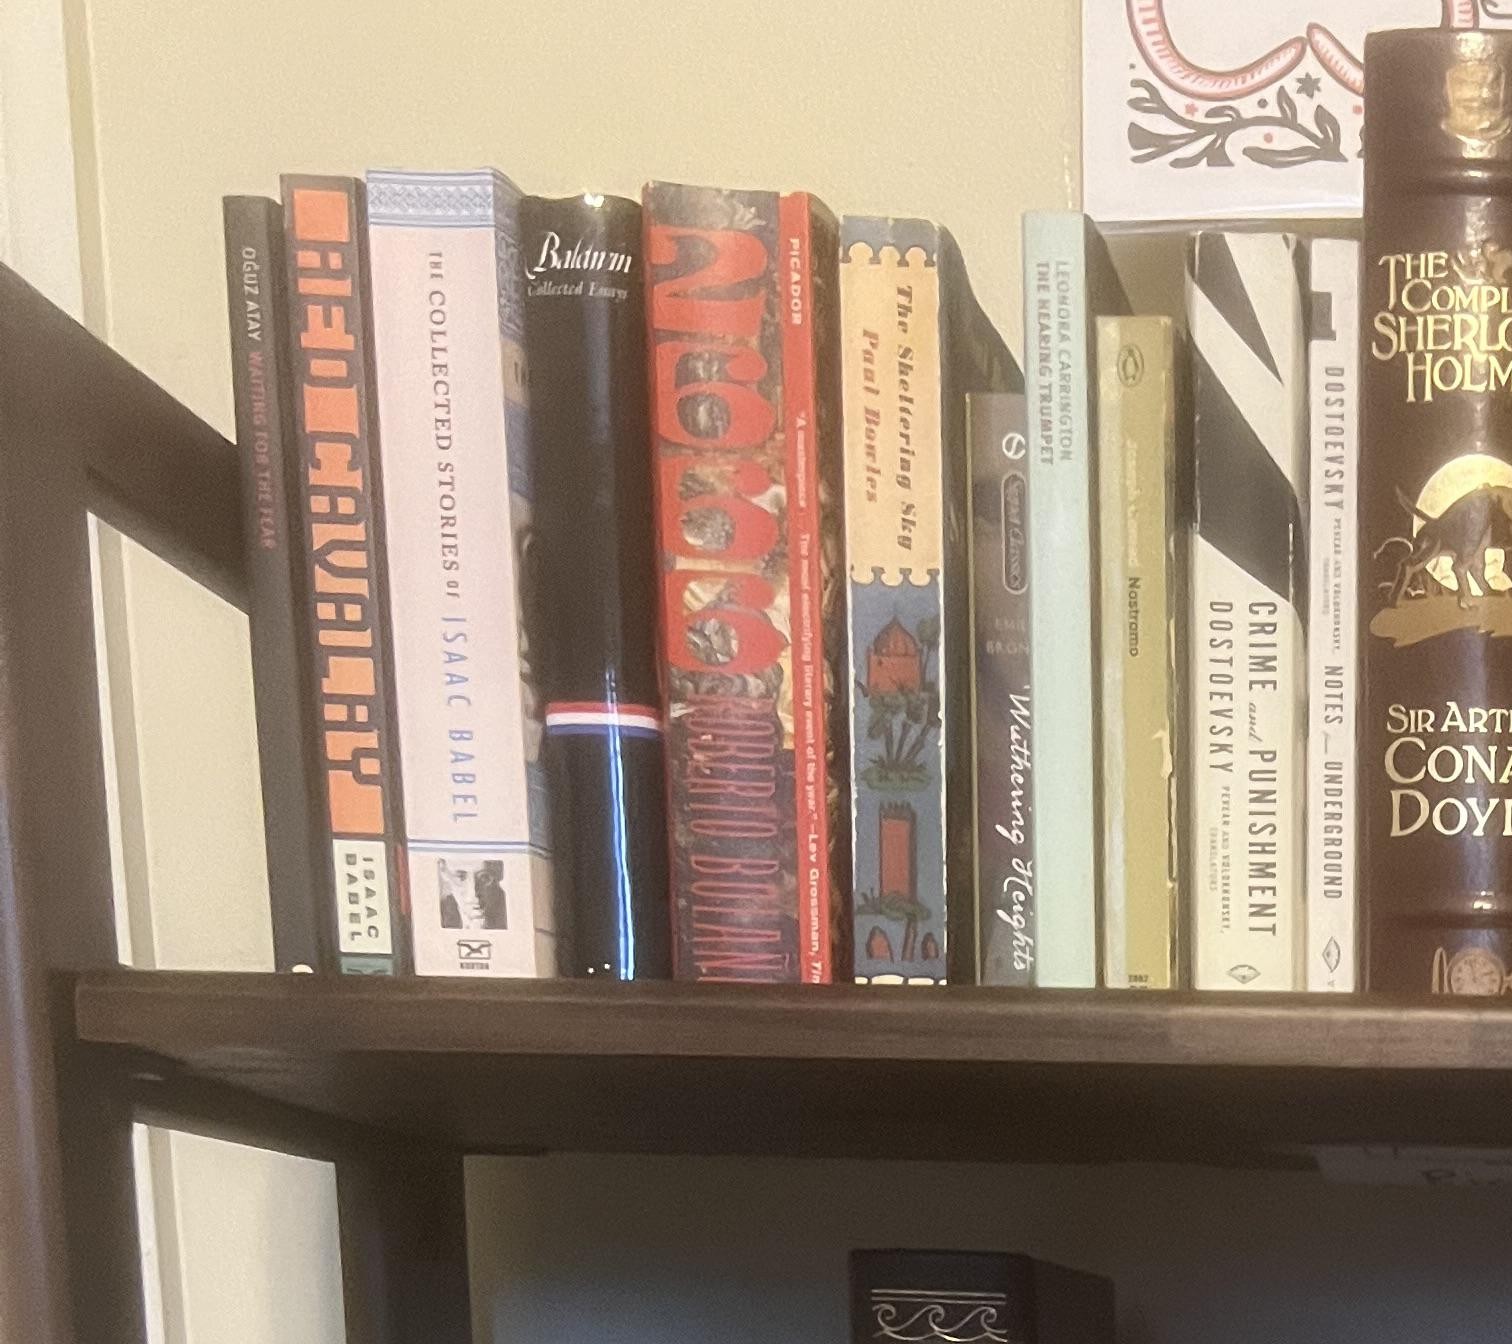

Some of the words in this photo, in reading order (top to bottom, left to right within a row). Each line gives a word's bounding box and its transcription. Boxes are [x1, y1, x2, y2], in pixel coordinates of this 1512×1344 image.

[429, 252, 443, 280] THE
[789, 237, 802, 326] PICADOR
[897, 284, 914, 335] The
[1036, 261, 1050, 289] THE
[1055, 259, 1071, 343] LEONORA
[1378, 251, 1450, 312] THE
[244, 300, 262, 342] ATAY
[862, 329, 881, 396] Paul
[1037, 292, 1052, 379] HEARING
[428, 290, 454, 451] COLLECTED
[1058, 345, 1074, 463] CARRINGTON
[863, 406, 881, 504] Bowles
[896, 344, 915, 492] Sheltering
[1039, 383, 1054, 467] TRUMPET
[1324, 366, 1345, 512] DOSTOEVSKY
[437, 462, 459, 572] STORIES
[896, 501, 917, 552] Sky
[1126, 576, 1141, 658] Nostromo
[1248, 601, 1278, 692] CRIME
[441, 617, 472, 707] ISAAC
[1208, 601, 1234, 774] DOSTOEVSKY
[1323, 665, 1344, 726] NOTES
[1248, 703, 1264, 743] and
[1386, 703, 1436, 735] SIR
[449, 729, 478, 823] BABEL
[995, 685, 1032, 846] Wuthering
[1248, 749, 1278, 937] PUNISHMENT
[1322, 761, 1344, 900] UNDERGROUND
[345, 853, 363, 941] BABEL
[361, 856, 380, 940] ISAAC
[997, 858, 1036, 972] Heights
